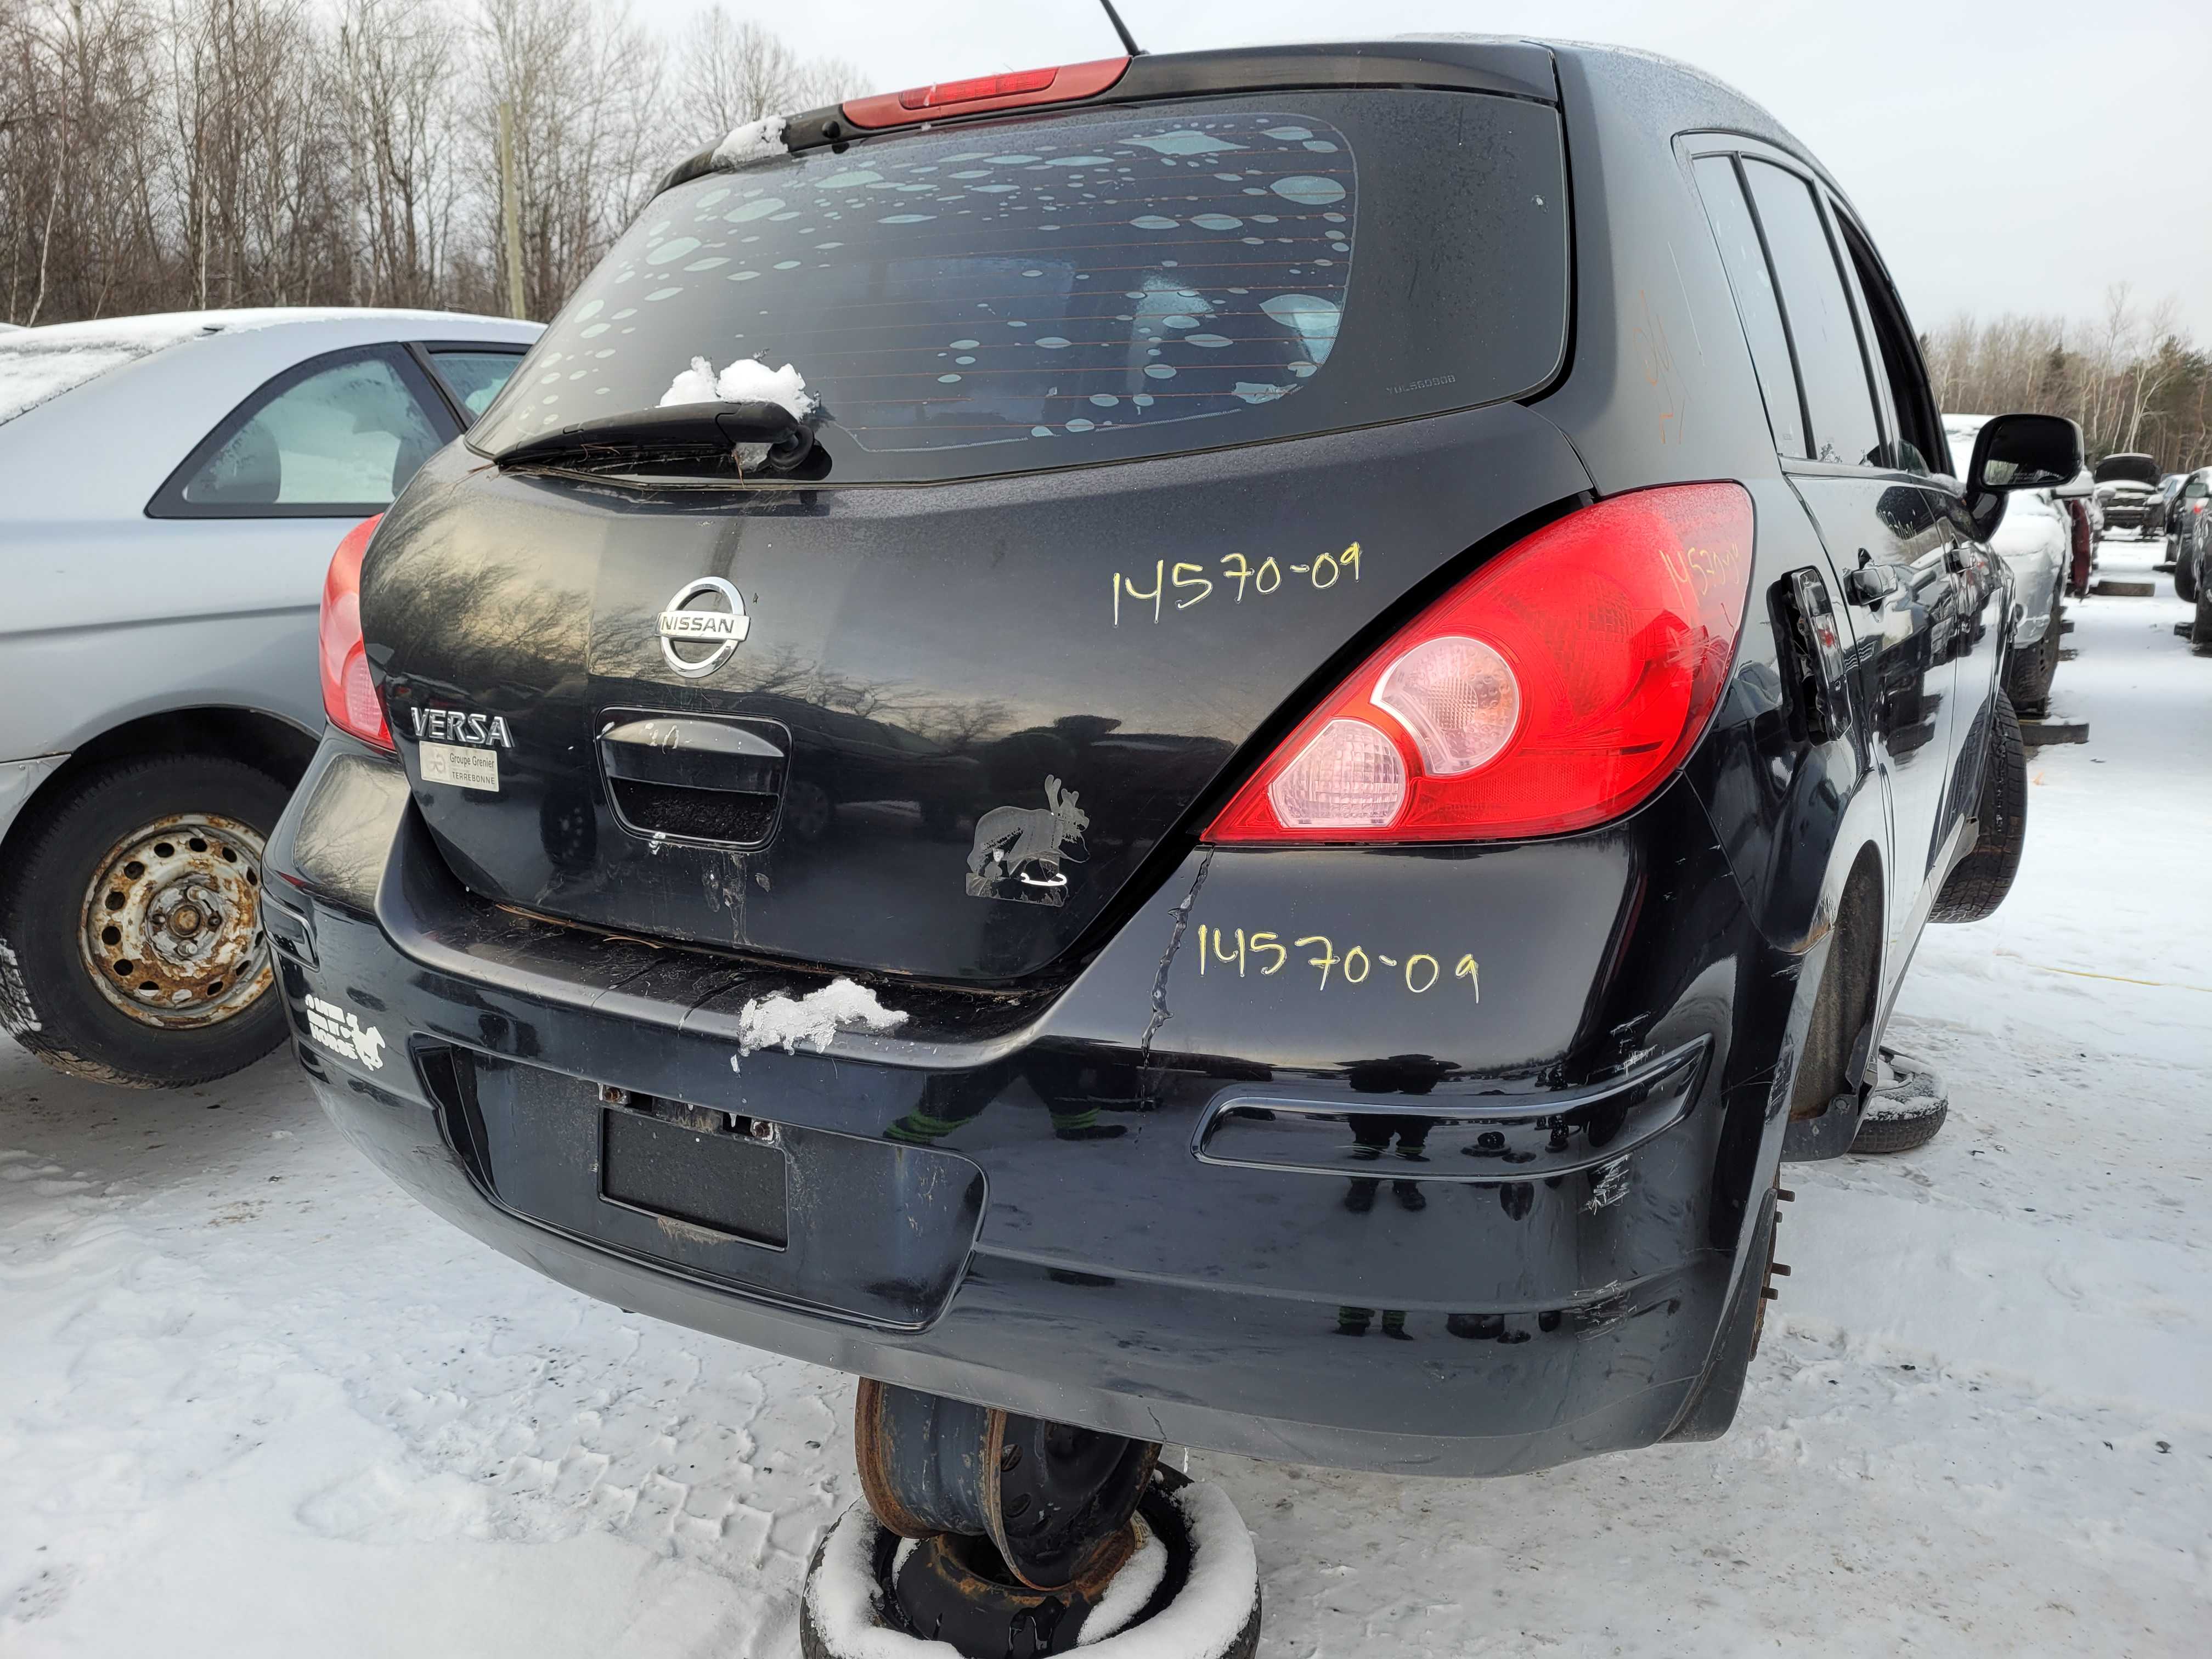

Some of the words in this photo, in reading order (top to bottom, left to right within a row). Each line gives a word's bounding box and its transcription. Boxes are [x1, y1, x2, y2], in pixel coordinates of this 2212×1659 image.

[1114, 541, 1361, 627] 14570-09
[661, 616, 735, 633] NISSAN
[411, 707, 515, 748] VERSA
[449, 752, 471, 768] Groupe
[472, 755, 494, 768] Grenier
[452, 771, 495, 785] TERREBONNE
[1198, 924, 1480, 1004] 14570-09
